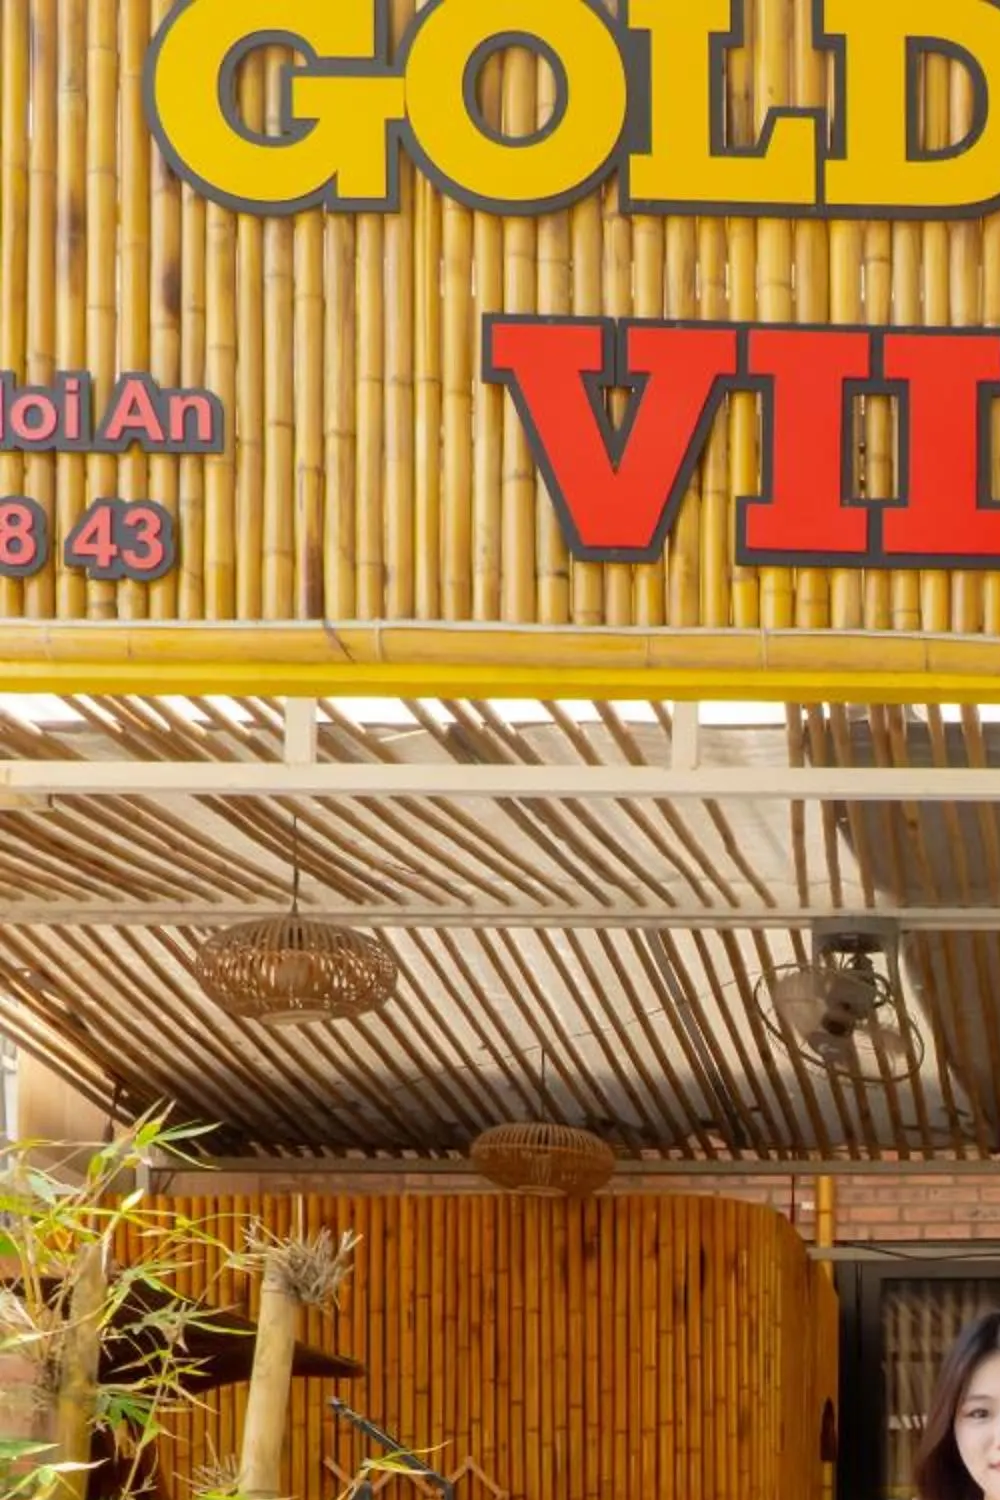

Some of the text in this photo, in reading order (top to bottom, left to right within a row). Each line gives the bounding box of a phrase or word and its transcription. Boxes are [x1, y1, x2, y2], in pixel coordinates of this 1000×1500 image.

[0, 378, 213, 442] oi An
[71, 505, 164, 571] 43
